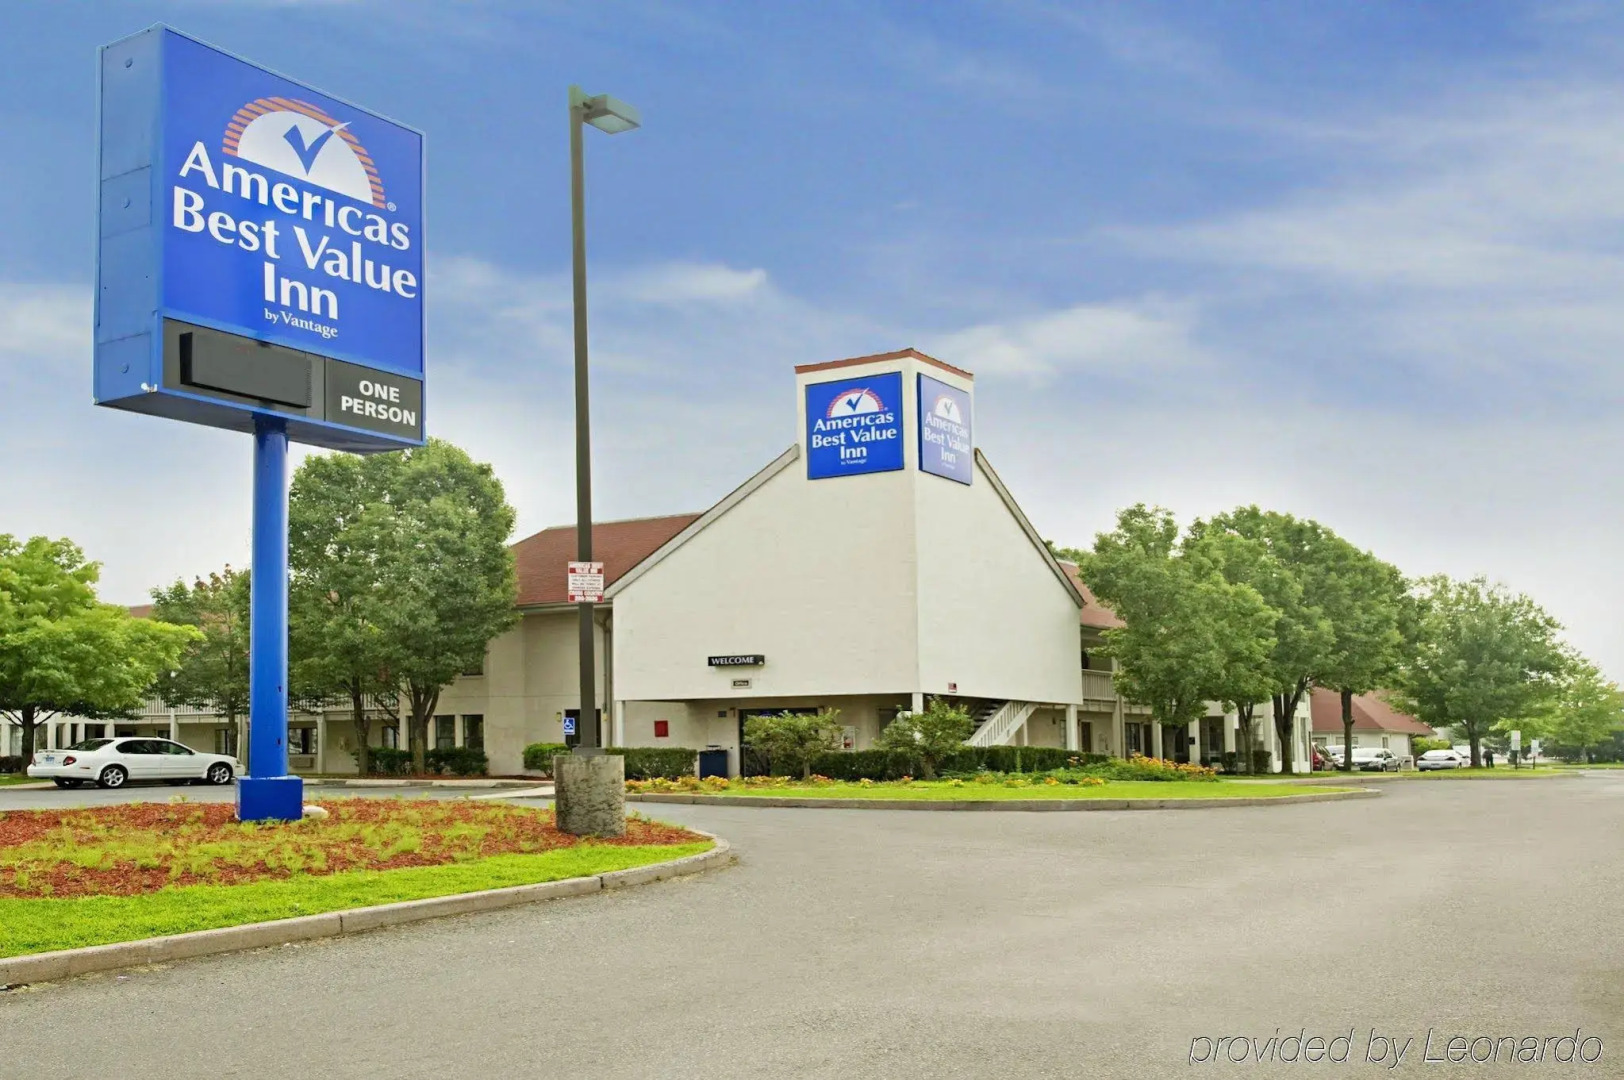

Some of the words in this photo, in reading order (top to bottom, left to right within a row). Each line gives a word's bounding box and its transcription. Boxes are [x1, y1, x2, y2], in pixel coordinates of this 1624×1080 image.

[179, 141, 410, 251] Americas
[173, 186, 280, 260] Best
[293, 225, 417, 299] Value
[264, 262, 339, 320] Inn
[264, 308, 279, 325] by
[281, 311, 338, 339] Vantage
[359, 380, 400, 403] ONE
[341, 395, 416, 427] PERSON
[813, 412, 894, 432] Americas
[924, 426, 945, 446] Best
[925, 411, 969, 439] Americas
[812, 431, 846, 448] Best
[850, 426, 897, 443] Value
[840, 446, 867, 459] Inn
[941, 446, 956, 464] Inn
[711, 656, 755, 665] WELCOME
